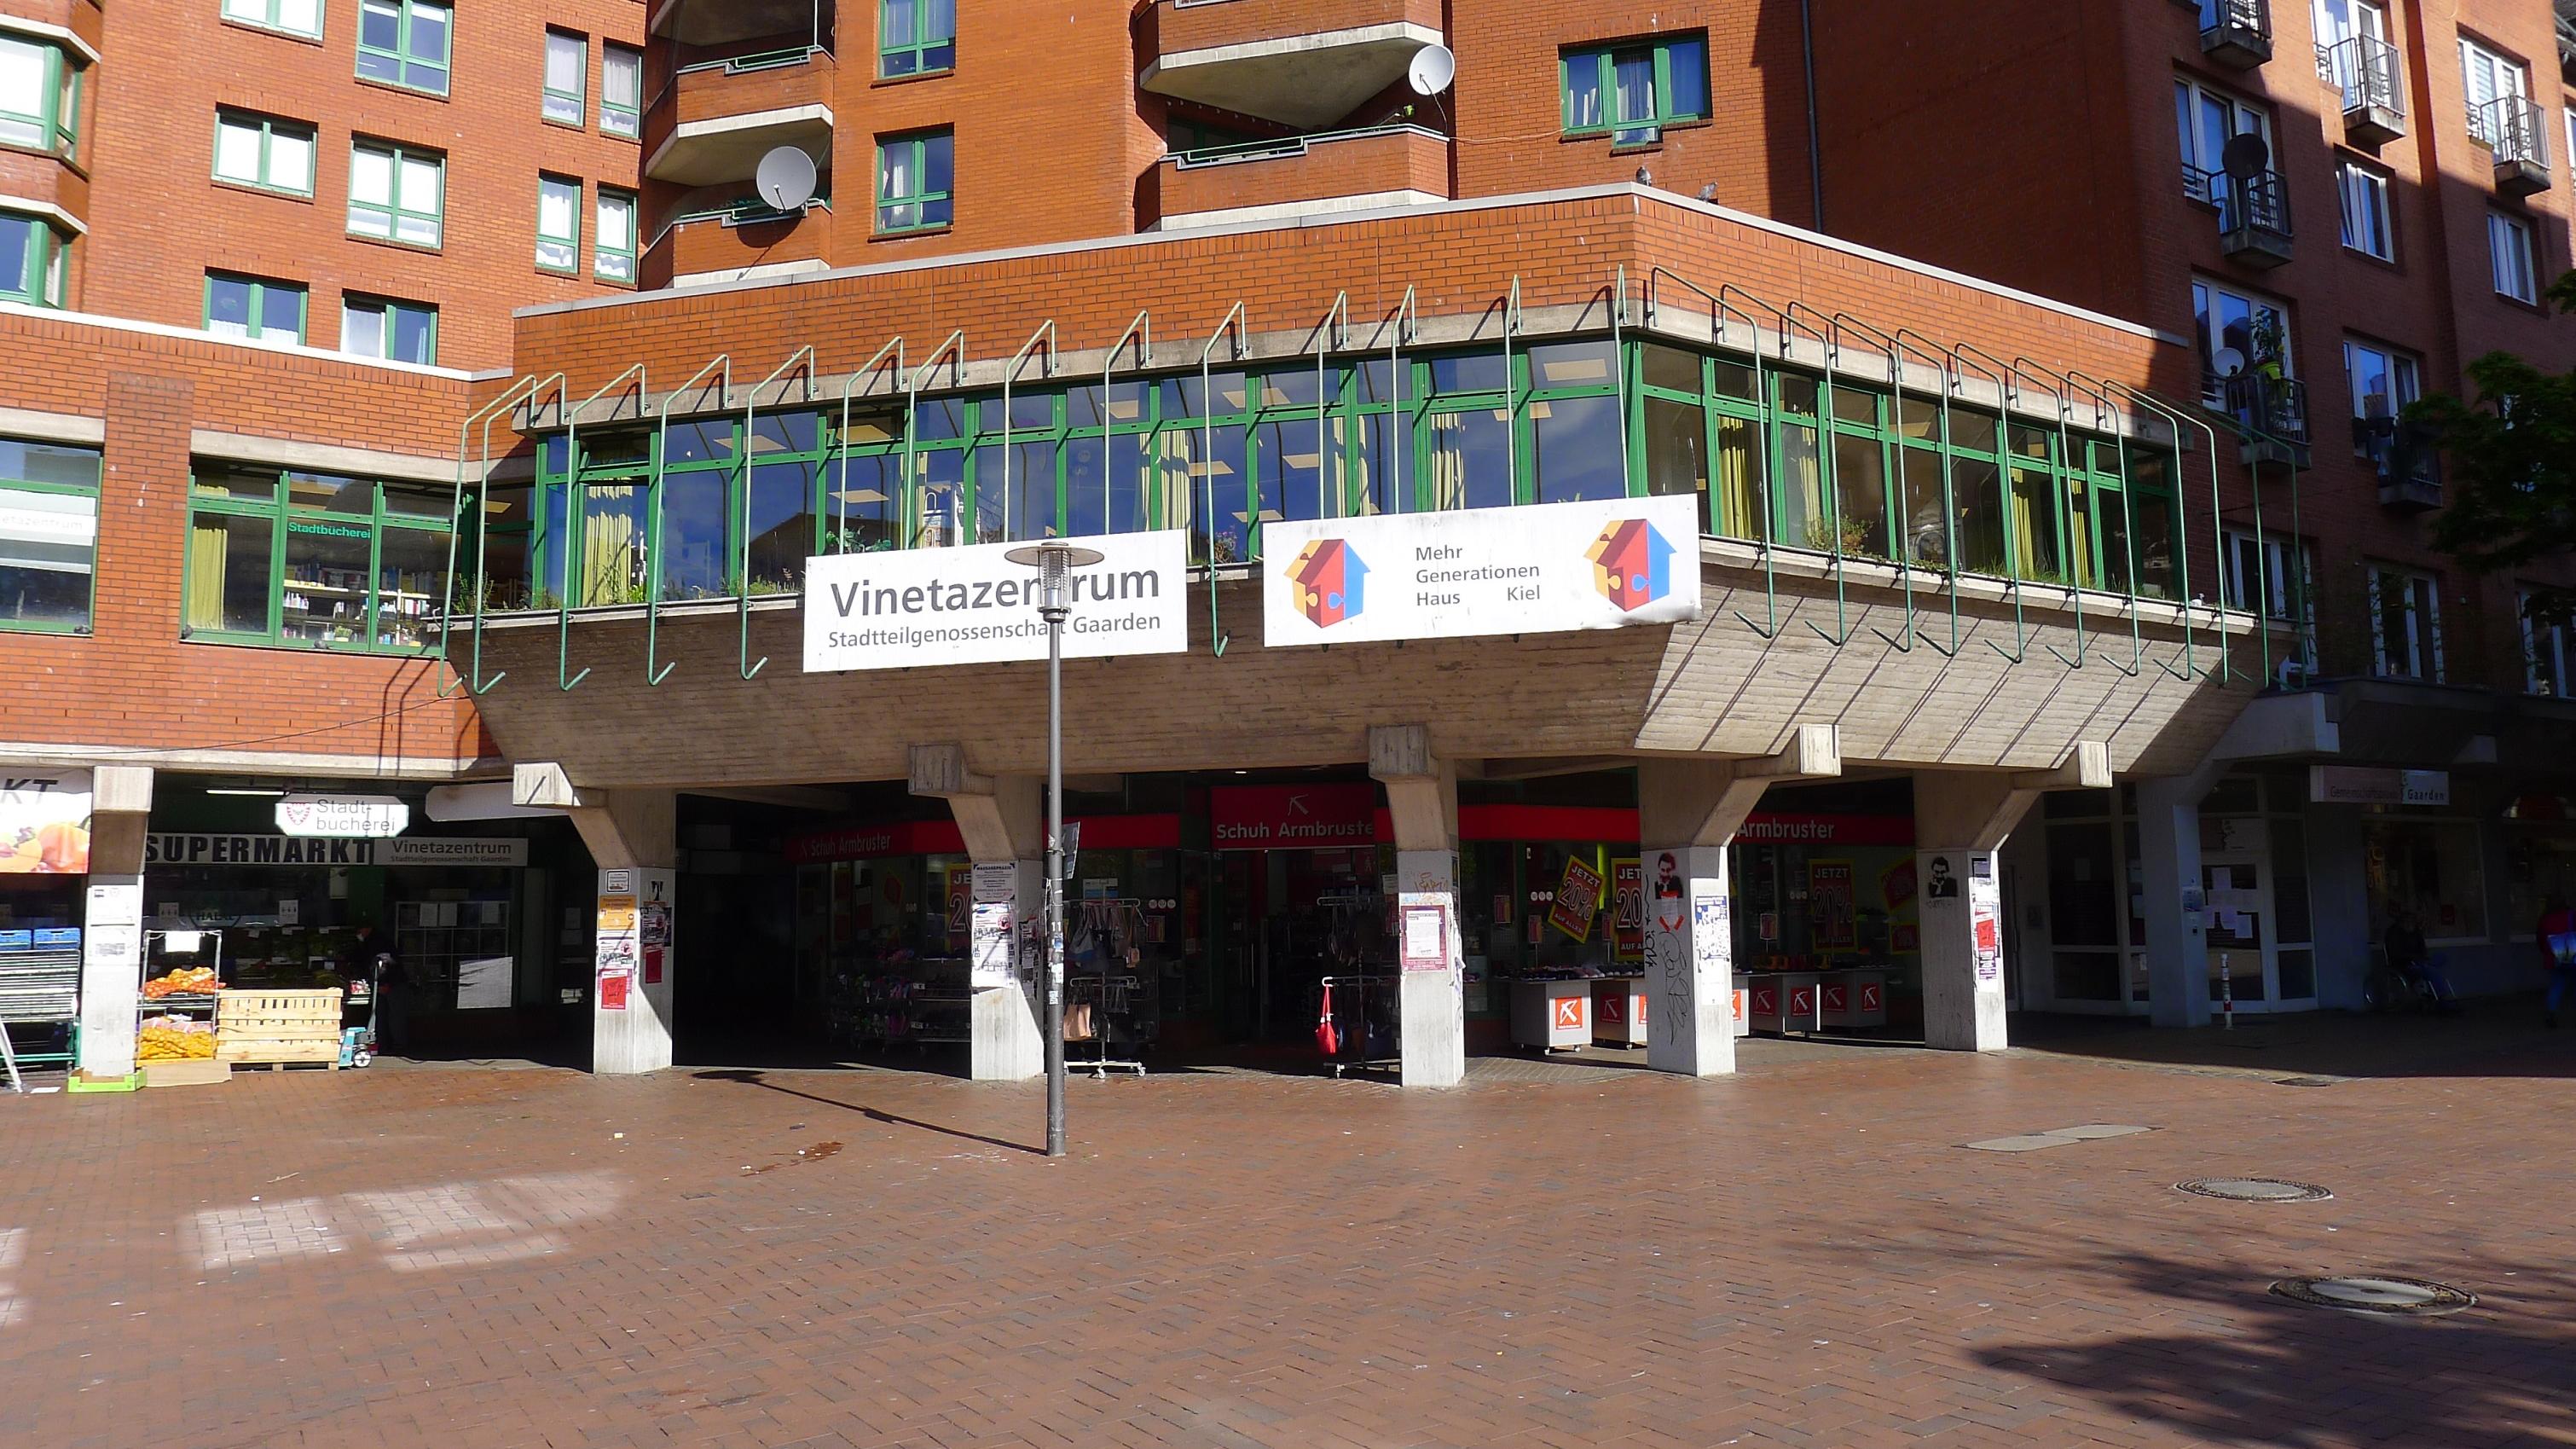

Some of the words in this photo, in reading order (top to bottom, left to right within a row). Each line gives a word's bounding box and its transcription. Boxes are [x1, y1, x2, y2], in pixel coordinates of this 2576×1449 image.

[287, 521, 372, 539] Stadtbücherei
[1415, 544, 1463, 561] Mehr
[1415, 565, 1540, 583] Generationen
[830, 568, 1161, 617] Vinetazenrum
[1416, 592, 1461, 606] Haus
[1507, 584, 1541, 601] Kiel
[828, 619, 1066, 648] Stadtteilgenossenschat
[1073, 612, 1161, 634] Gaarden
[2407, 788, 2445, 801] Gaarden
[1216, 822, 1270, 839] Schuh
[1736, 817, 1835, 838] Armbruster
[145, 836, 370, 863] SUPERMARKT
[391, 839, 512, 854] Vinetazentrum
[810, 836, 836, 856] Schuh
[838, 832, 892, 854] Armbruster
[1571, 866, 1601, 888] JETZT
[1815, 867, 1850, 879] JETZT
[1557, 877, 1597, 921] 20%
[1621, 942, 1635, 951] AUF
